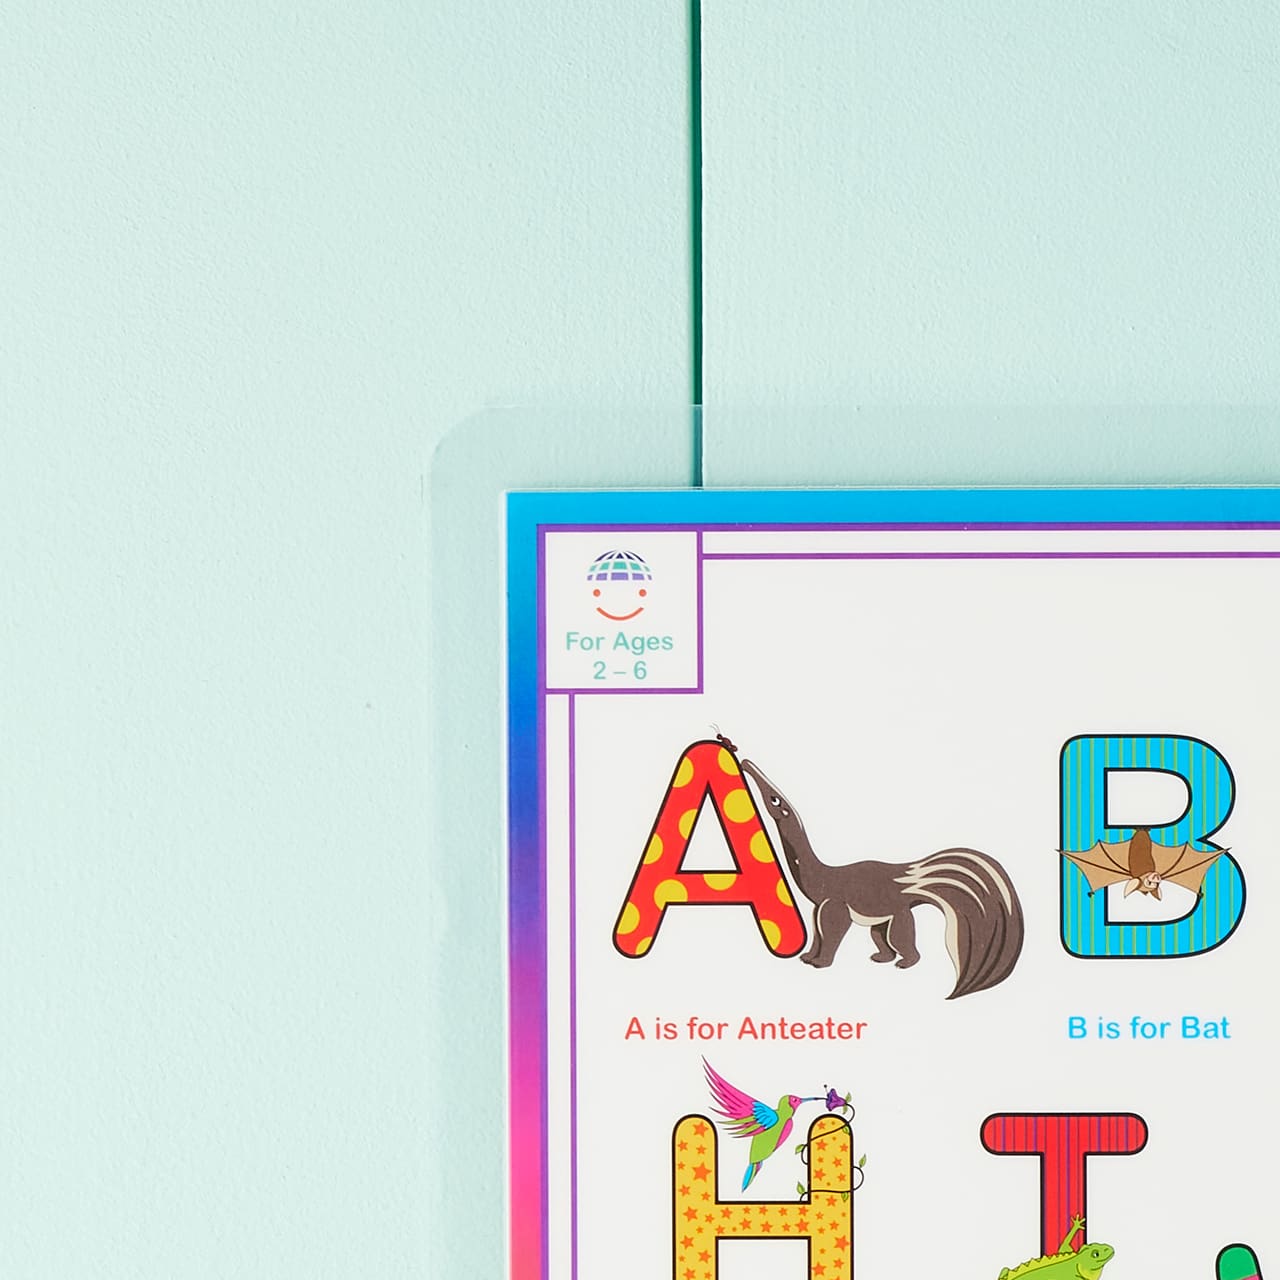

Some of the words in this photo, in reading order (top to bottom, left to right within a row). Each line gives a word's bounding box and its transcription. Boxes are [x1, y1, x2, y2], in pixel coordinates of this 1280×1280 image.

[567, 632, 604, 650] For
[613, 632, 673, 655] Ages
[594, 661, 606, 679] 2
[634, 661, 646, 679] 6
[612, 740, 808, 959] A
[625, 1017, 645, 1040] A
[656, 1017, 678, 1040] is
[687, 1017, 728, 1040] for
[738, 1017, 867, 1040] Anteater
